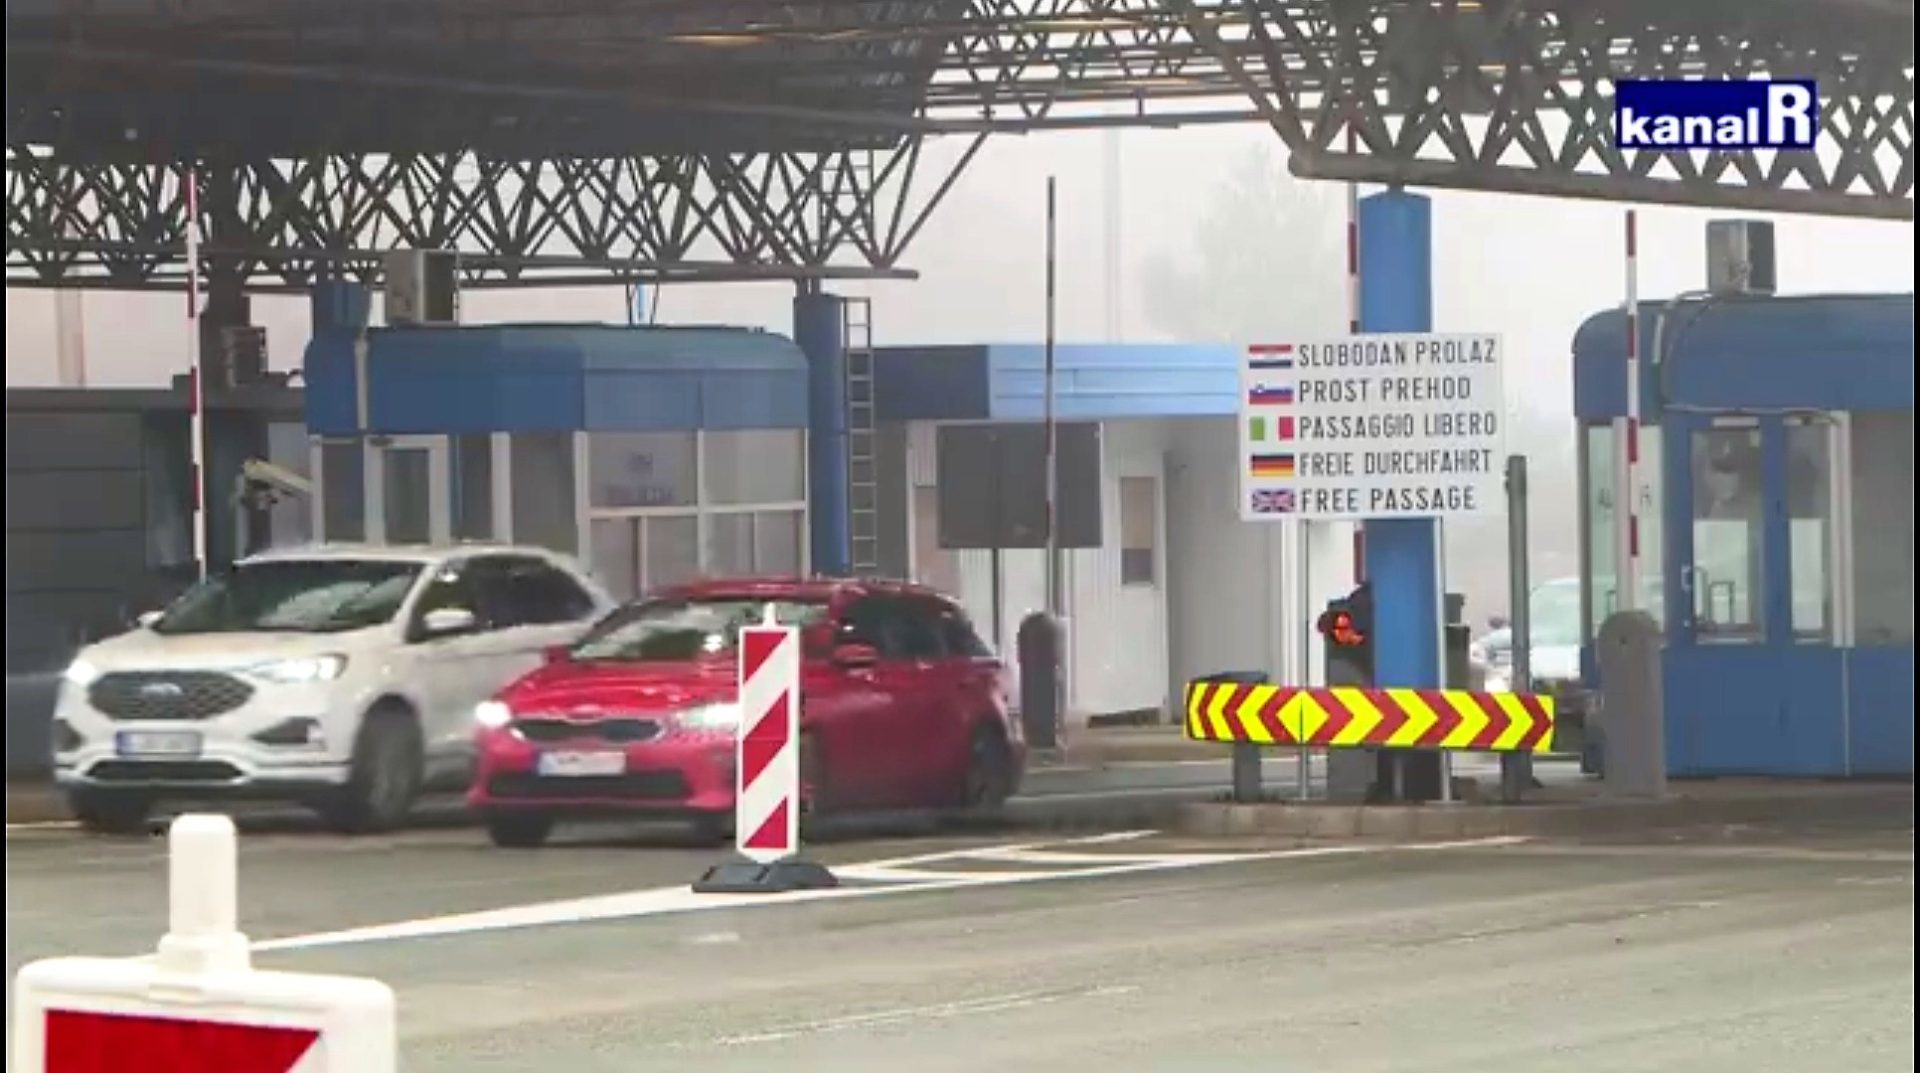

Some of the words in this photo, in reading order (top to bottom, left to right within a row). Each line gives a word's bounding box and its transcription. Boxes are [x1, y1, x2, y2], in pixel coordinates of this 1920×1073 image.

[1299, 342, 1407, 367] SLOBODAN
[1415, 340, 1496, 364] PROLAZ
[1299, 378, 1371, 403] PROST
[1383, 377, 1471, 401] PREHOD
[1299, 416, 1415, 439] PASSAGGIO
[1424, 413, 1497, 436] LIBERO
[1299, 453, 1354, 475] FREIE
[1364, 450, 1492, 474] DURCHFAHRT
[1301, 488, 1360, 512] FREE
[1371, 486, 1476, 511] PASSAGE
